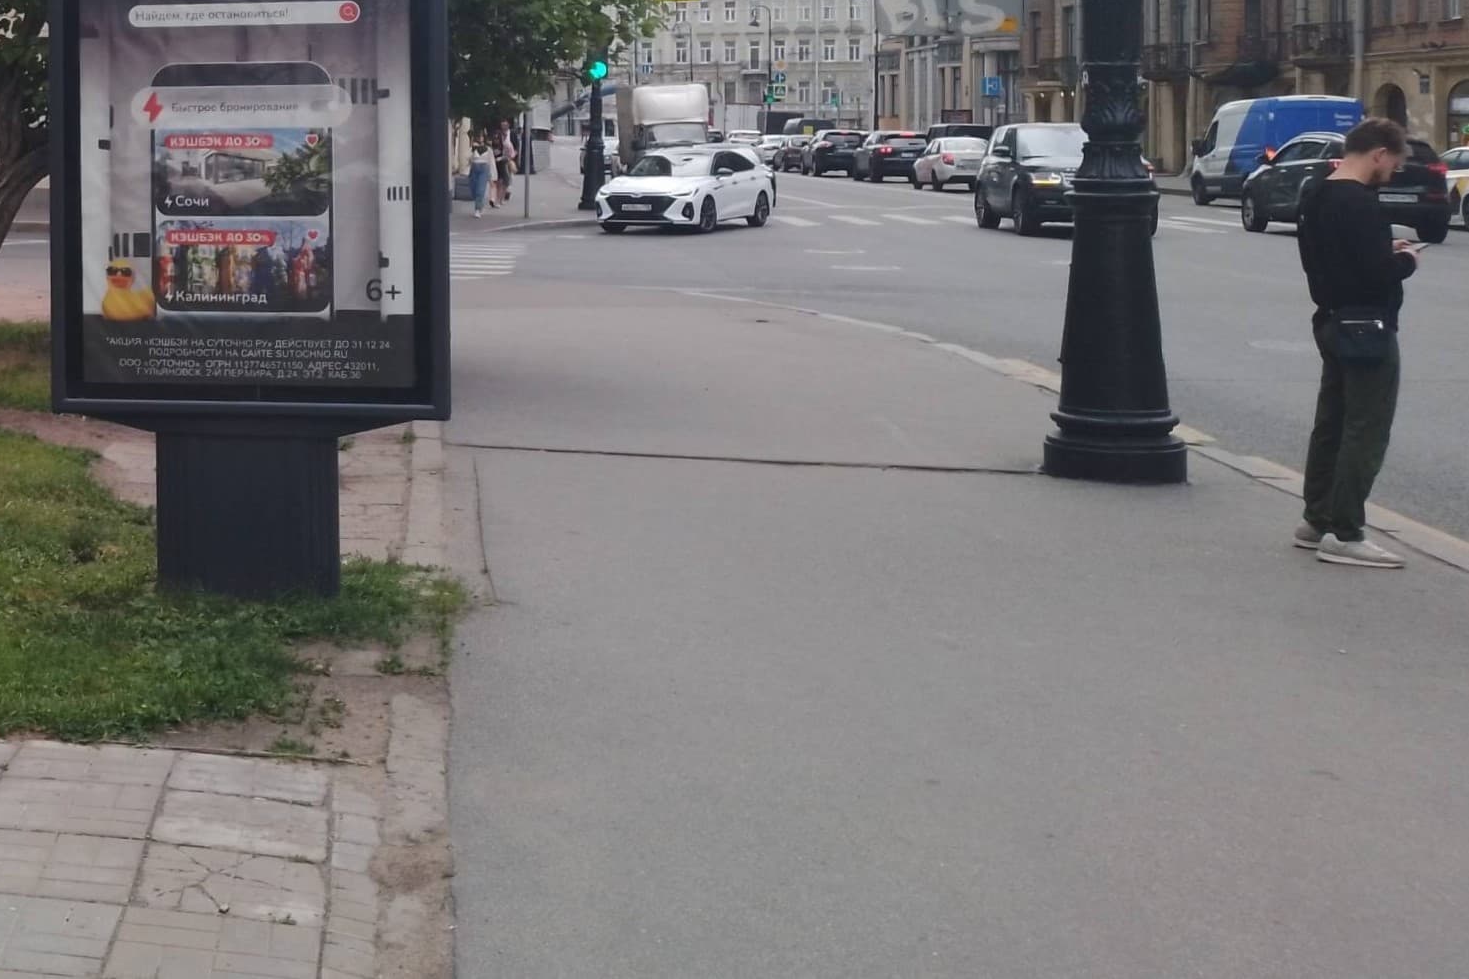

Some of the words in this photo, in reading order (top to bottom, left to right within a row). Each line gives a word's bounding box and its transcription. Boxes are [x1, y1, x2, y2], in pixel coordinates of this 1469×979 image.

[185, 11, 205, 23] где
[171, 103, 217, 114] Быстрое
[219, 99, 298, 112] бронирование
[170, 136, 221, 147] КЭШБЭК
[225, 136, 242, 147] ДО
[175, 195, 209, 207] Сочи
[171, 232, 222, 243] КЭШБЭК
[226, 232, 243, 243] ДО
[365, 279, 402, 302] 6+
[175, 290, 268, 304] Калининград
[191, 339, 204, 347] НА
[275, 339, 332, 350] ДЕЙСТВУЕТ
[335, 340, 349, 349] ДО
[149, 347, 221, 357] ПОДРОБНОСТИ
[225, 349, 238, 357] НА
[241, 348, 273, 358] САЙТЕ
[119, 358, 142, 367] ООО
[205, 359, 231, 368] ОГРН
